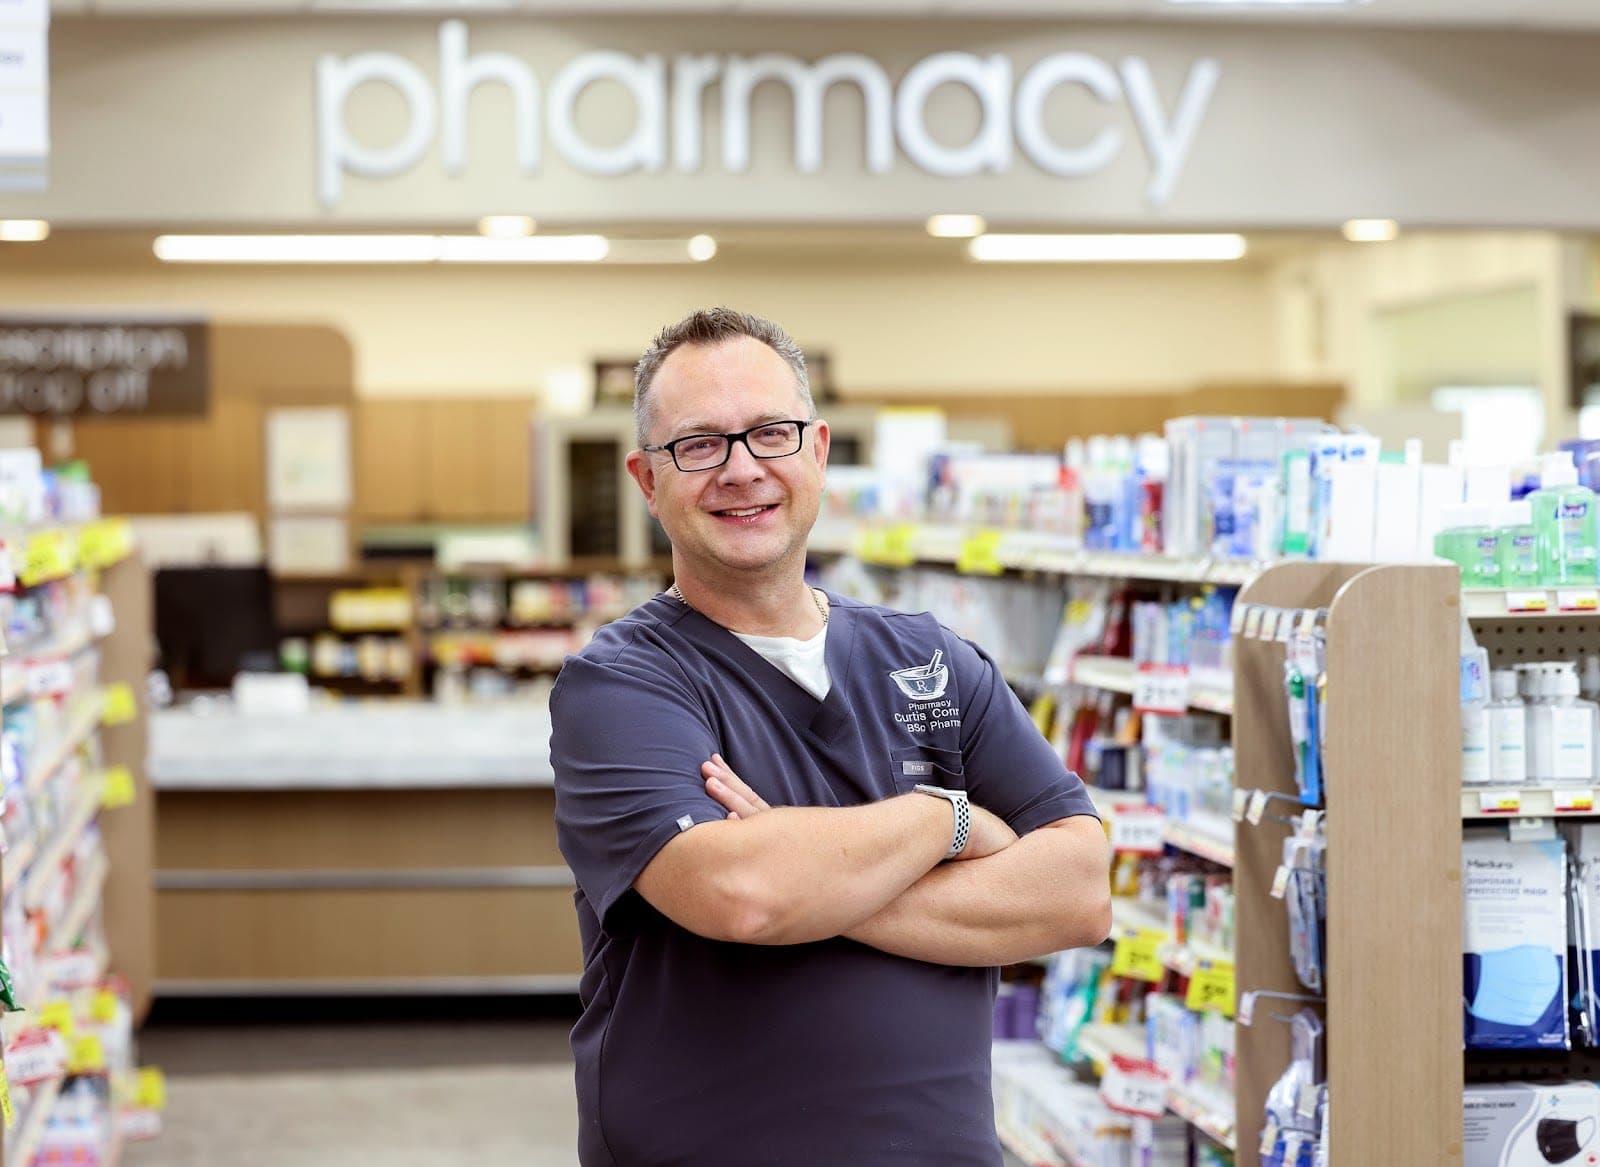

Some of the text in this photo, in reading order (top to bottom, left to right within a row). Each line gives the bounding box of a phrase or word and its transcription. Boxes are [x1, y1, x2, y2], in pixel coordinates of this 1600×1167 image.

[315, 19, 1220, 206] pharmacy
[908, 699, 951, 711] Pharmacy
[894, 710, 927, 723] Curtis
[907, 723, 926, 733] BSc
